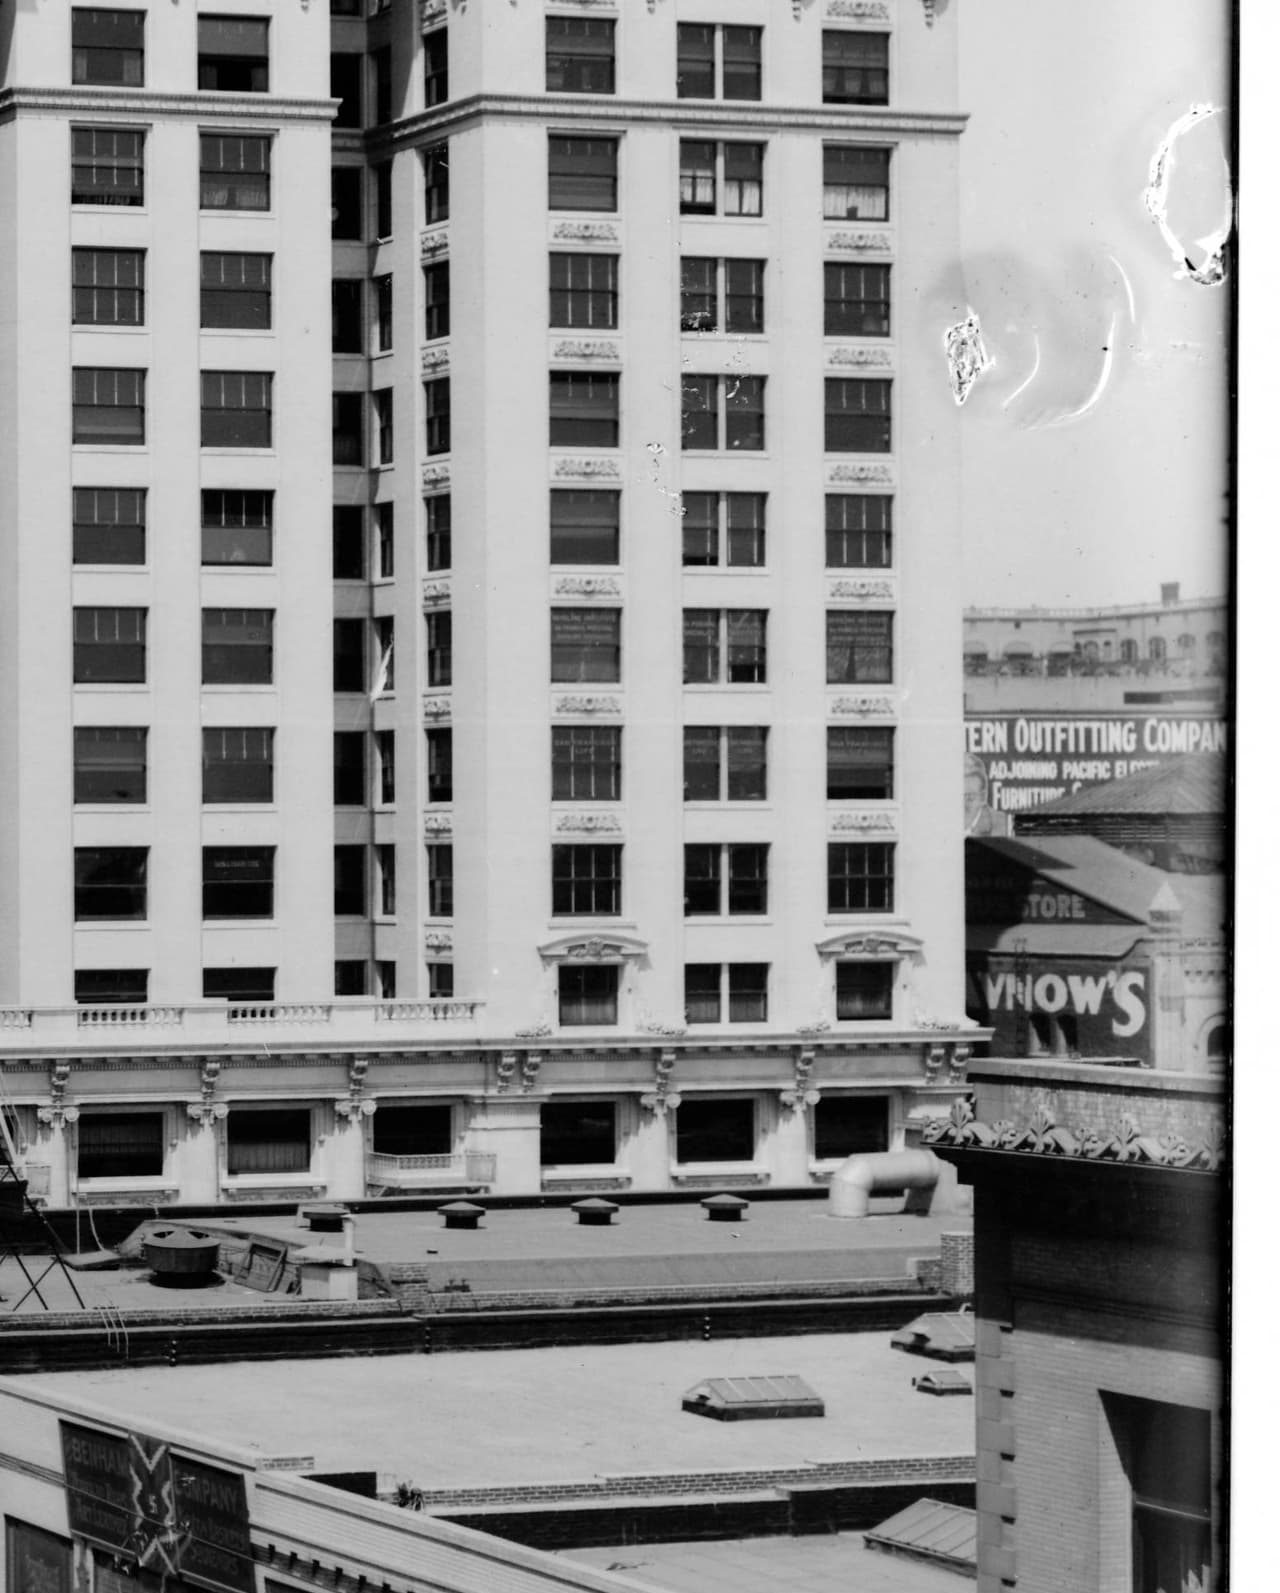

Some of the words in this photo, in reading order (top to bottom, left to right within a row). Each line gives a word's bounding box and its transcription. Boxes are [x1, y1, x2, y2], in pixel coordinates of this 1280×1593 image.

[1014, 718, 1137, 753] OUTFITTING
[989, 761, 1058, 780] ADJOINING
[1063, 761, 1111, 780] PACIFIC
